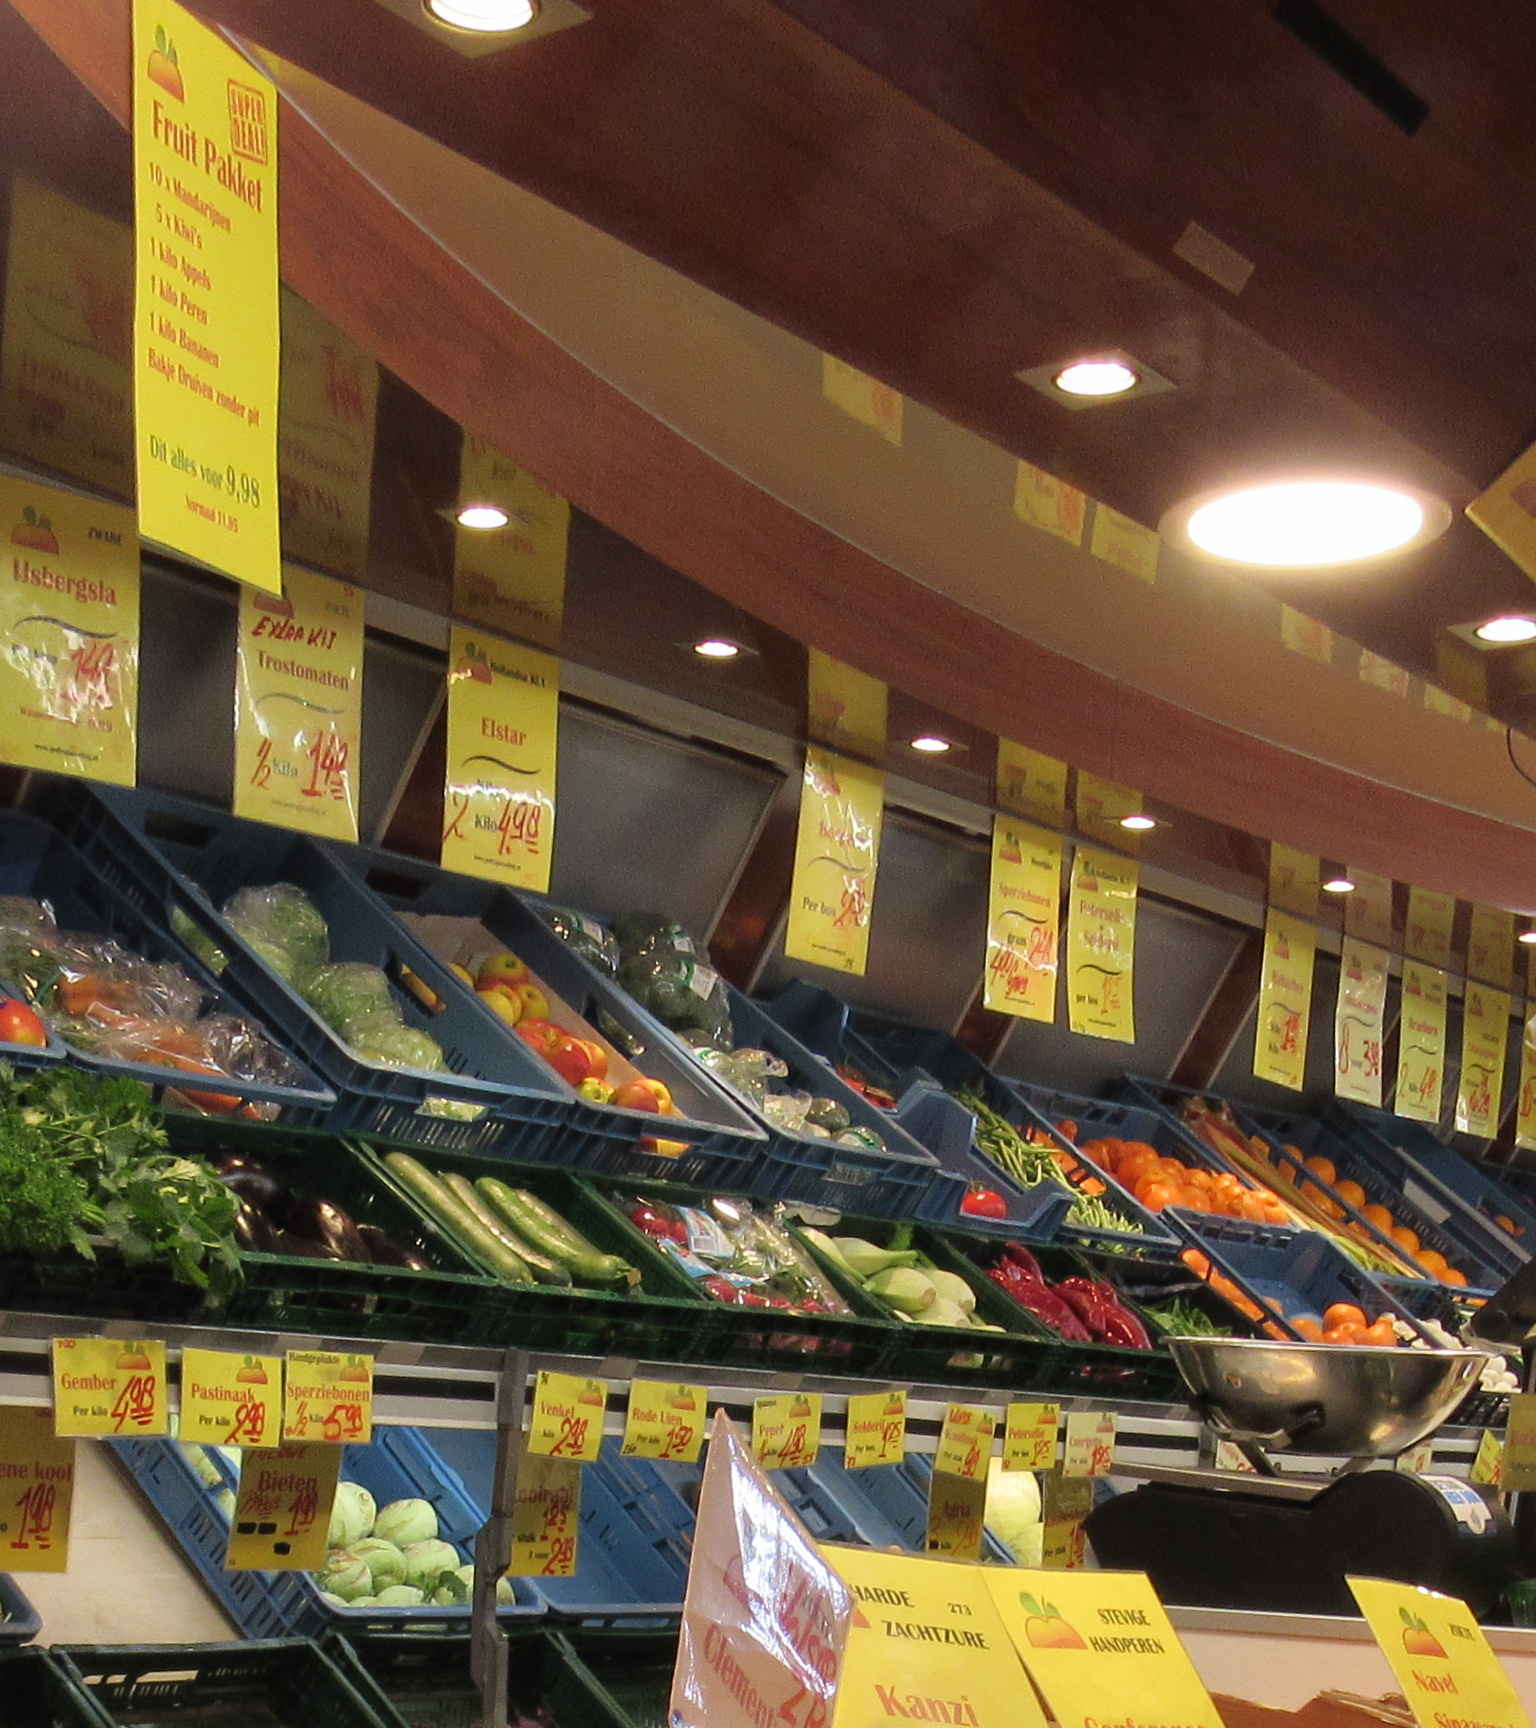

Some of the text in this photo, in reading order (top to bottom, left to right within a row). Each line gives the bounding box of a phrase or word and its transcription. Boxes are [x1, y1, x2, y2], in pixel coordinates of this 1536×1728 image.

[153, 99, 262, 213] Fruit Pakket
[149, 161, 163, 186] 10
[173, 177, 232, 234] Mandarijnen
[155, 202, 162, 224] 5
[174, 214, 203, 250] Kiwi's
[159, 244, 178, 271] kilo
[181, 255, 213, 291] Appels
[159, 281, 178, 307] kilo
[180, 292, 208, 325] Peren
[158, 319, 177, 344] kilo
[179, 329, 220, 370] Bananen
[148, 348, 261, 427] Bakje Druiven zonder pit
[149, 434, 261, 509] Dit alles voor 9,98
[12, 558, 117, 606] IJsbergsla
[258, 650, 349, 690] Trostomaten
[481, 717, 527, 747] Elstar
[273, 758, 298, 778] Kilo
[474, 814, 497, 834] Kilo
[61, 1373, 116, 1391] Gember
[191, 1383, 255, 1402] Pastinaak
[286, 1381, 370, 1402] Sperziebonen
[73, 1406, 89, 1416] Per
[92, 1406, 108, 1417] kilo
[199, 1415, 213, 1425] Per
[215, 1416, 230, 1427] kilo
[541, 1400, 575, 1418] Venkel
[633, 1407, 657, 1423] Rode
[34, 1458, 73, 1483] kool
[258, 1470, 318, 1494] Bieten
[852, 1584, 915, 1609] HARDE
[948, 1602, 972, 1616] 273
[1098, 1608, 1150, 1627] STEVIGE
[883, 1620, 990, 1650] ZACHTZURE
[1090, 1636, 1165, 1655] HANDPEREN
[1411, 1669, 1459, 1695] Navel
[875, 1682, 979, 1728] Kanzi
